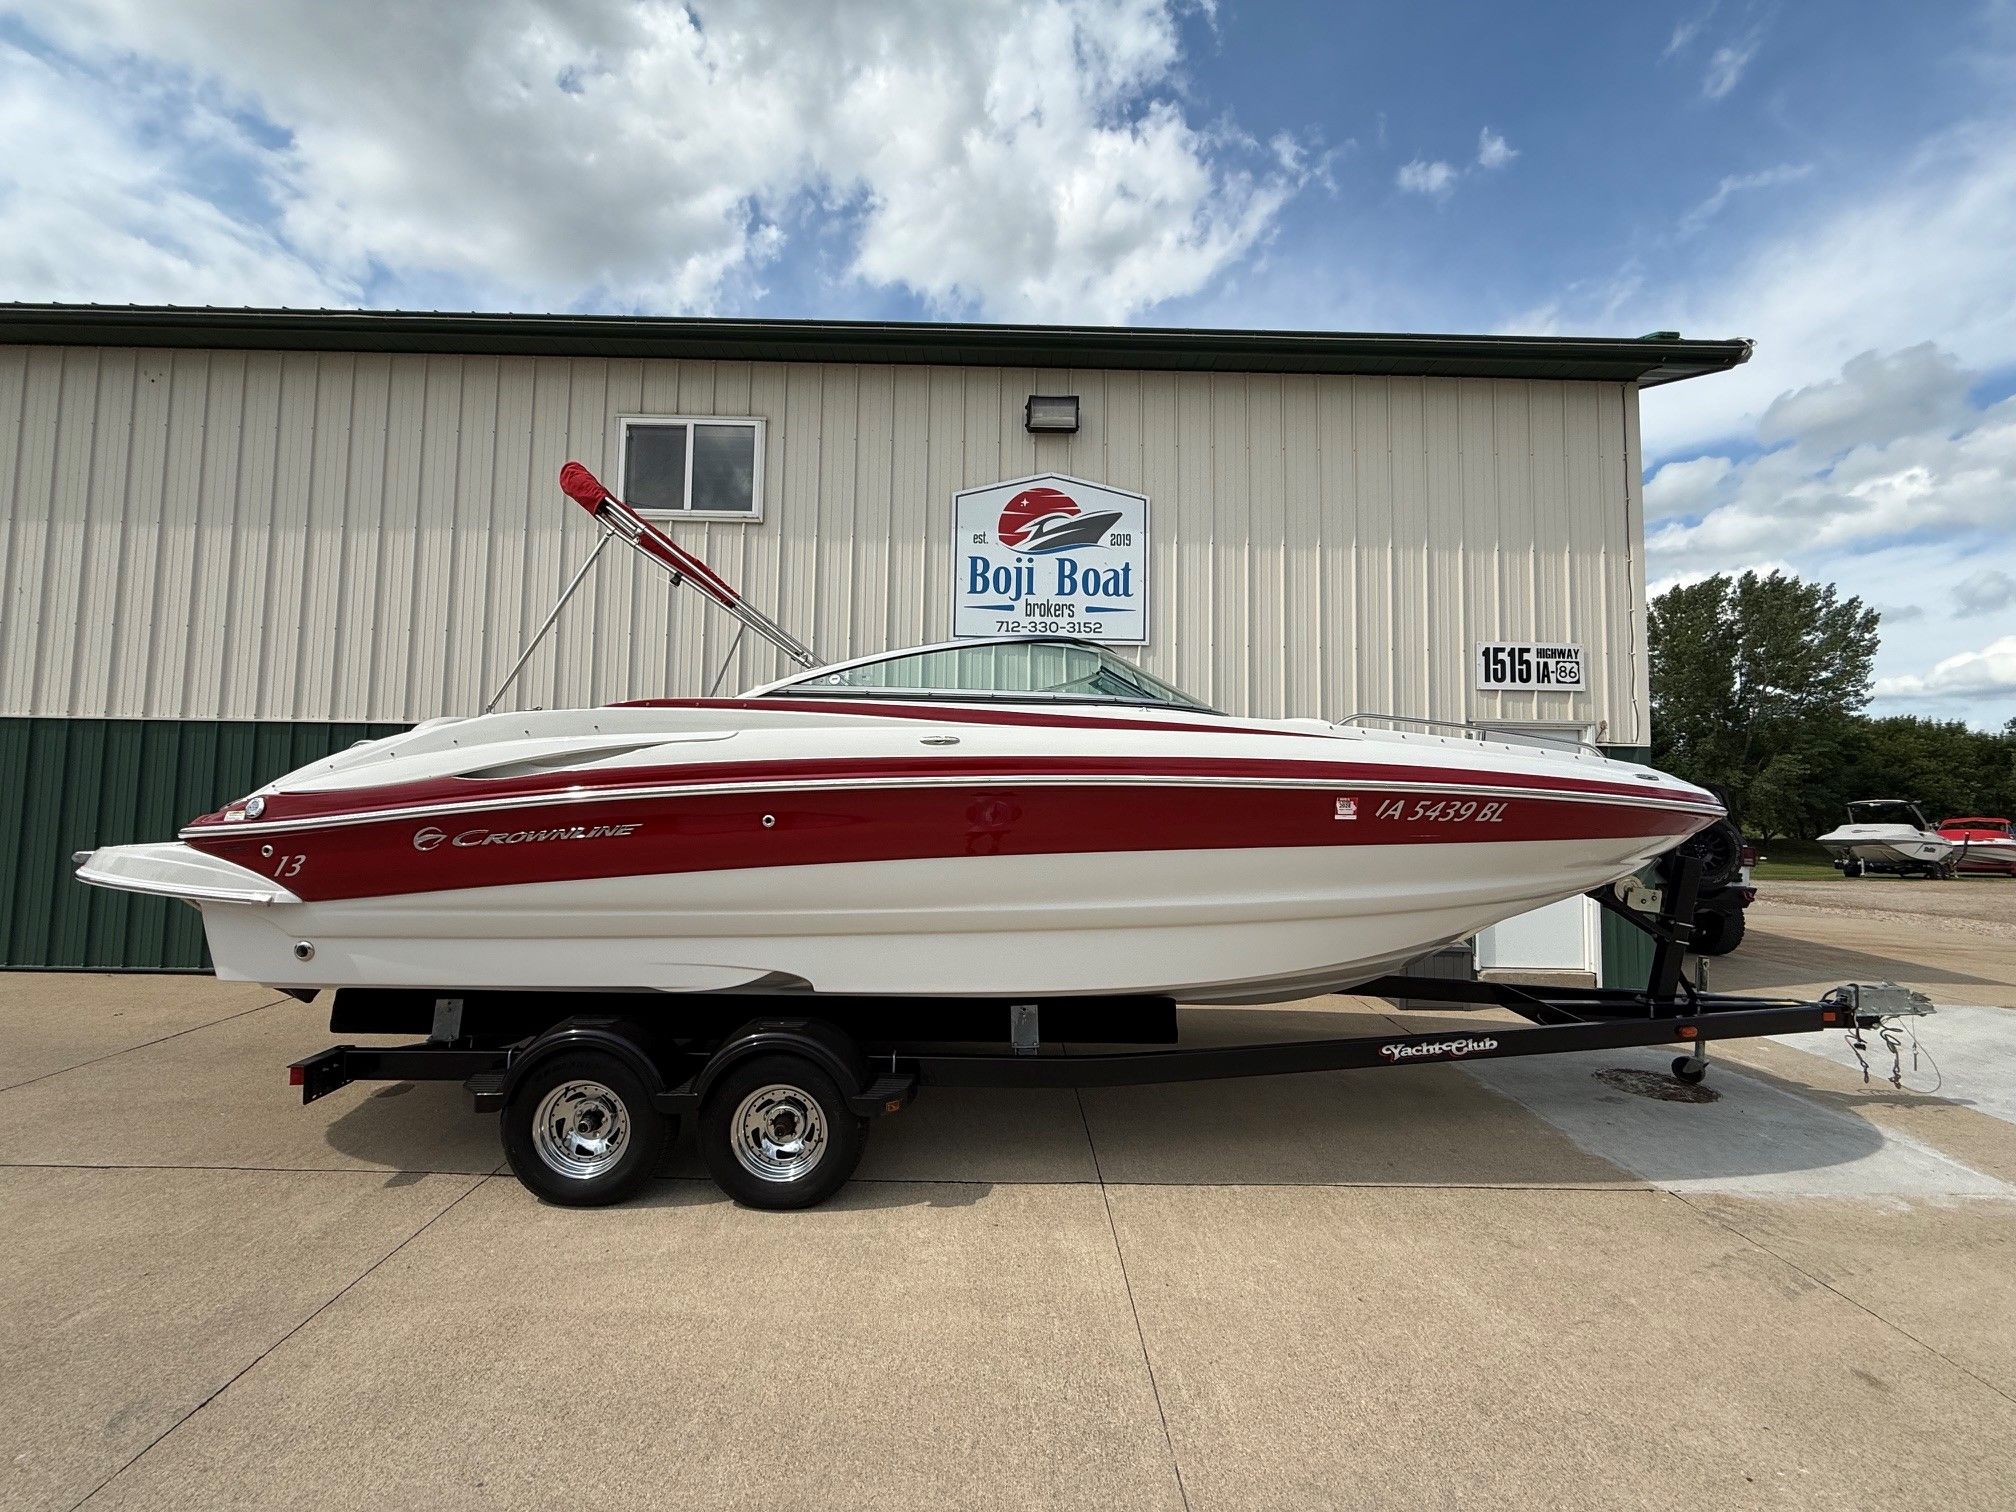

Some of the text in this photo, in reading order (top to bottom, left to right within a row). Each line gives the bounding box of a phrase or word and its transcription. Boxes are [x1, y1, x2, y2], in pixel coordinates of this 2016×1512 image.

[973, 531, 989, 544] est.
[1110, 533, 1132, 547] 2019
[967, 555, 1134, 601] Boji Boat
[1025, 598, 1075, 618] brokers
[996, 620, 1103, 634] 712-330-3152
[1536, 648, 1580, 660] HIGHWAY
[1482, 646, 1532, 683] 1515
[1375, 799, 1405, 820] IA
[1407, 800, 1478, 822] 5439
[1474, 802, 1508, 822] BL
[274, 854, 307, 877] 13
